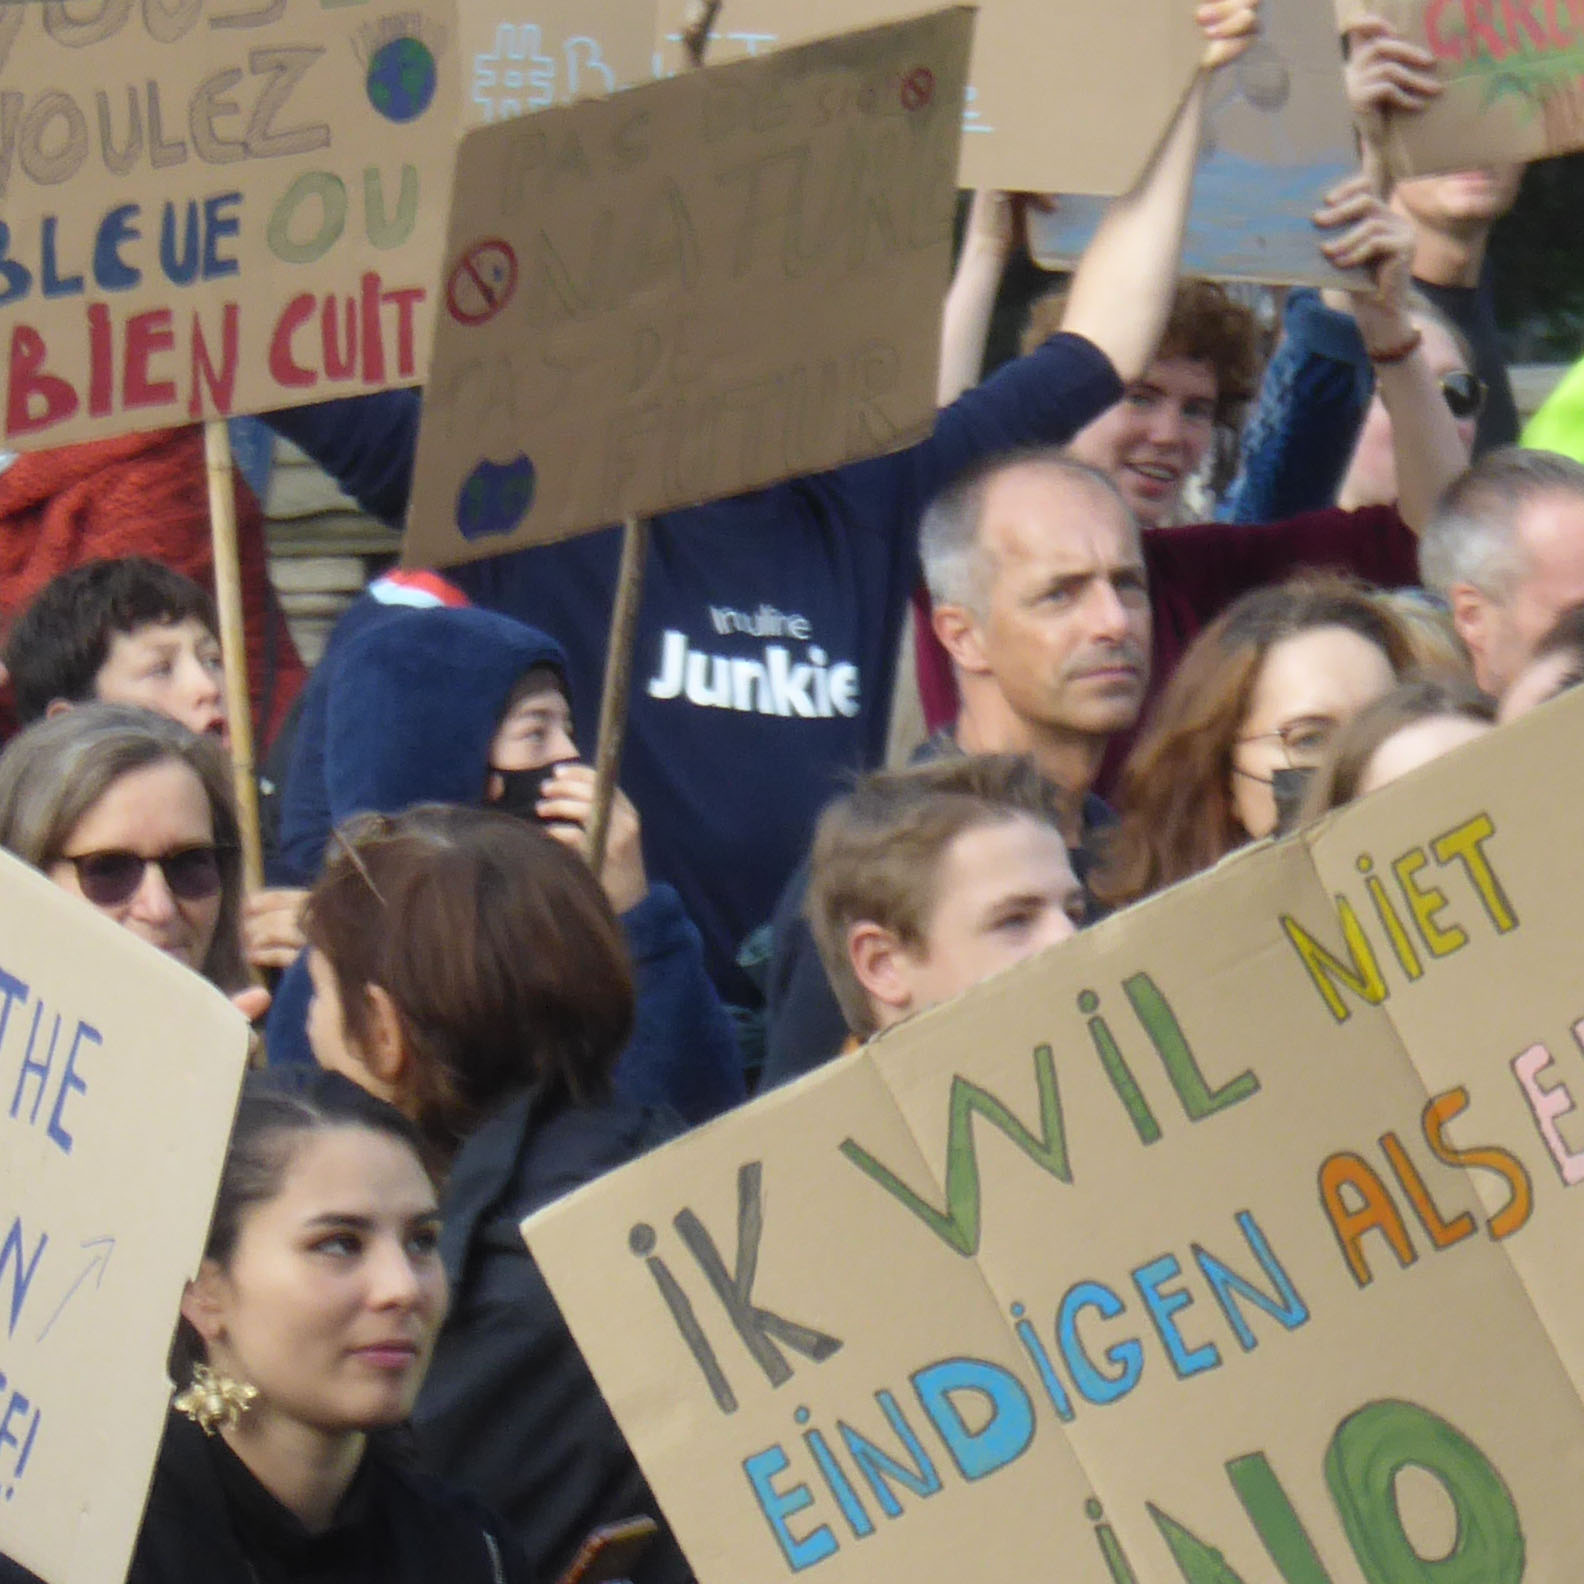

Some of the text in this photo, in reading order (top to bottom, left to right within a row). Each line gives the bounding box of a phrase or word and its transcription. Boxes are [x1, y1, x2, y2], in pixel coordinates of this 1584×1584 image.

[266, 164, 420, 264] OU
[6, 270, 427, 438] BIEN CUIT
[647, 628, 863, 718] Junkie
[1317, 1086, 1535, 1288] ALS
